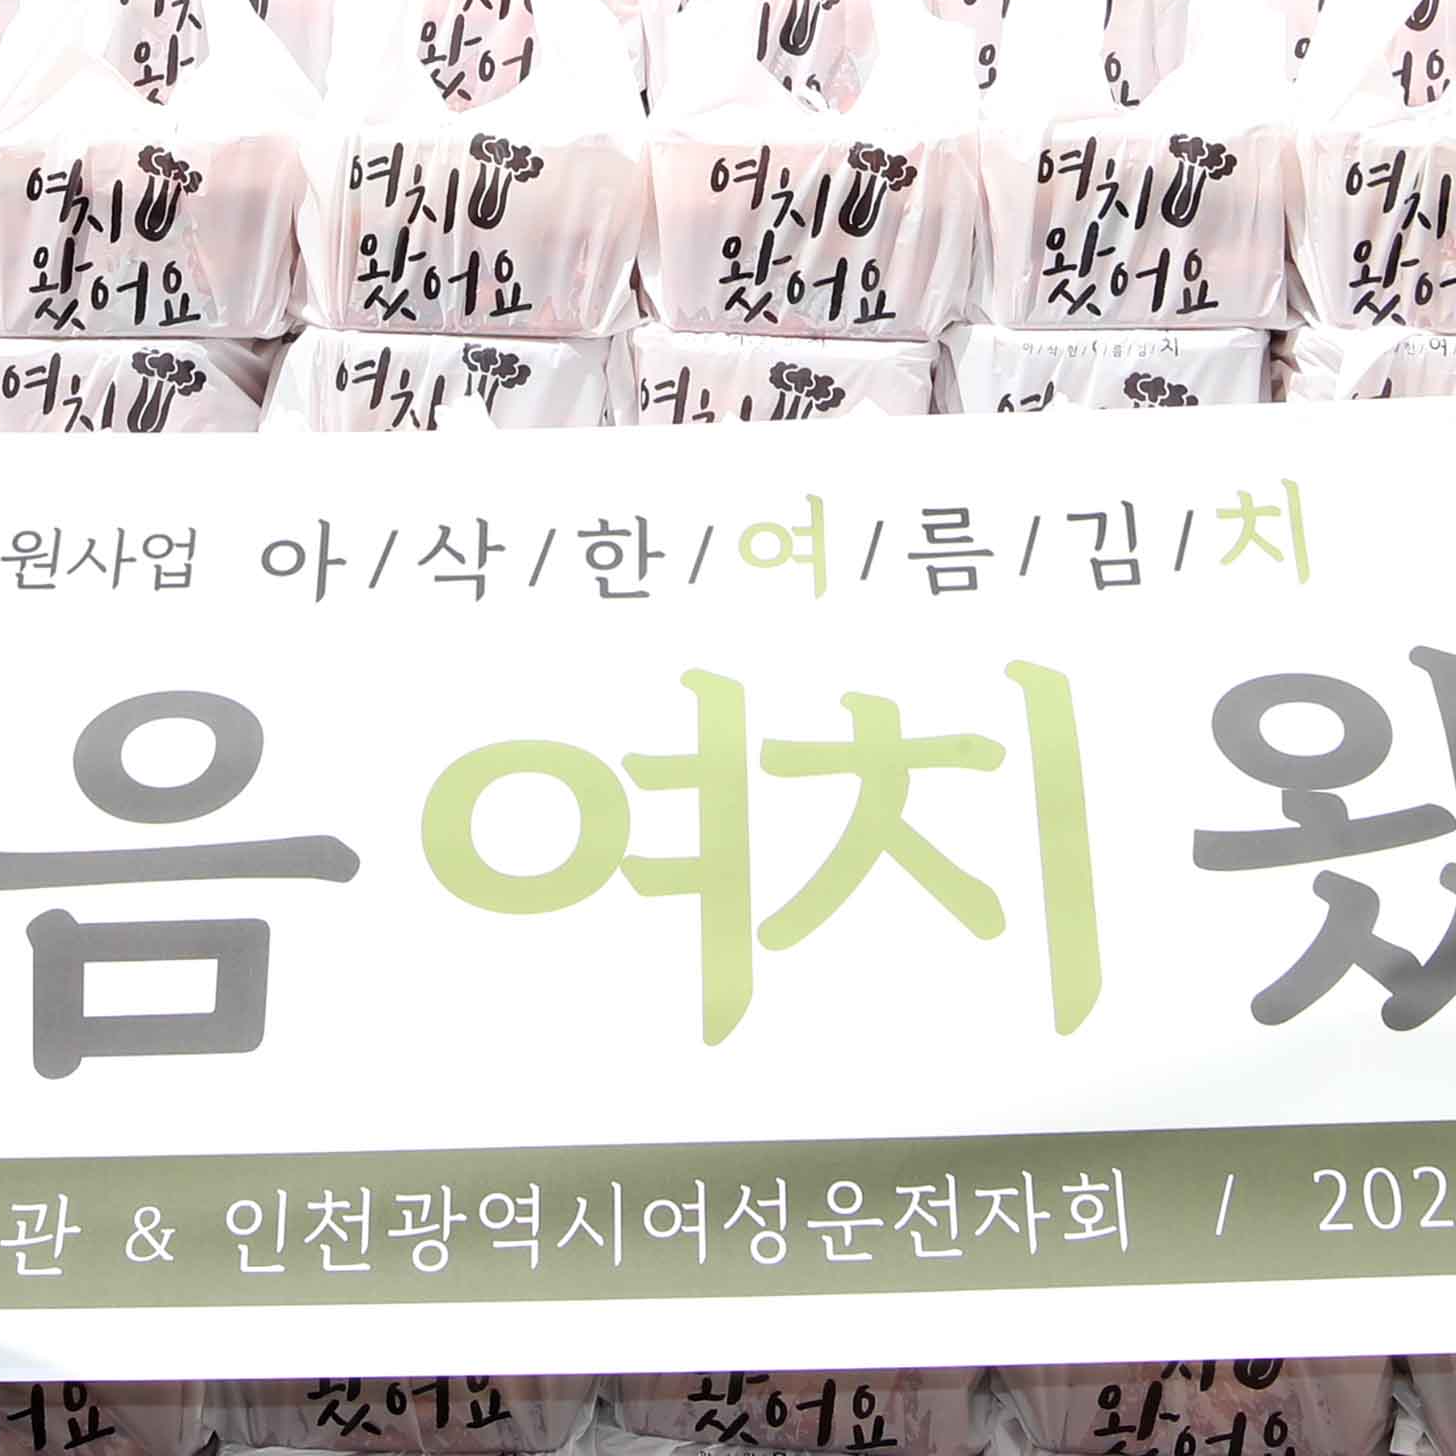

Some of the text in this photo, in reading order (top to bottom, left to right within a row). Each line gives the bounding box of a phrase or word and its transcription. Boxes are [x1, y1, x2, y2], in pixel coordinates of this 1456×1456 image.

[420, 13, 535, 101] 왔어
[27, 158, 124, 244] 여치
[349, 142, 459, 234] 여치
[710, 144, 832, 238] 여치
[1037, 135, 1154, 230] 여치
[1346, 149, 1452, 240] 여치
[29, 236, 201, 331] 왔어요
[357, 225, 533, 322] 왔어요
[718, 229, 897, 324] 왔어요
[1043, 221, 1219, 317] 왔어요
[418, 656, 1104, 1046] 여치
[123, 1205, 176, 1263] &
[224, 1167, 1130, 1273] 인천광역시여성운전자회
